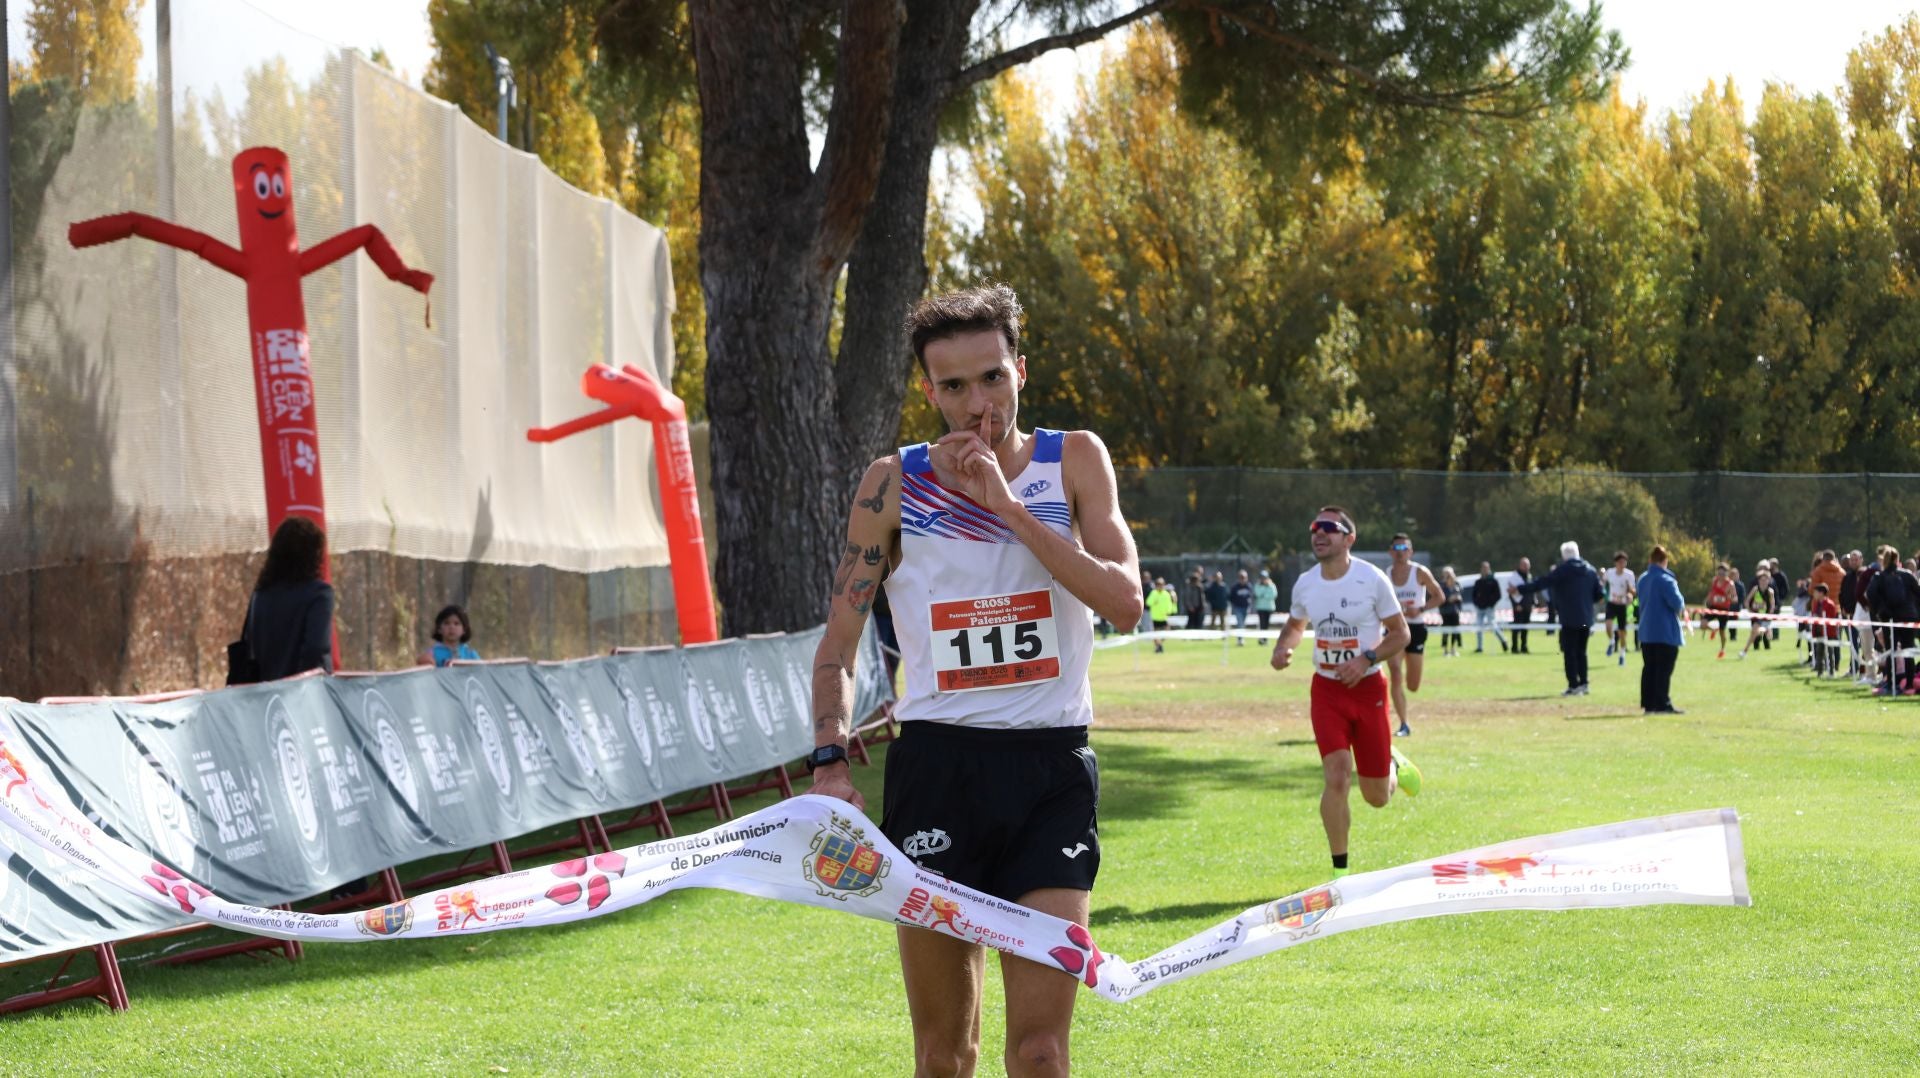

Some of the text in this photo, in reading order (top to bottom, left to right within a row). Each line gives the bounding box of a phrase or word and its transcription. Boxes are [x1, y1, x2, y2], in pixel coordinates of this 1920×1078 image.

[272, 379, 289, 418] CIA
[973, 596, 1011, 609] CROSS
[976, 608, 1005, 616] Municipal
[970, 613, 1018, 626] Palencia
[950, 621, 1043, 667] 115
[227, 790, 252, 815] LEN
[236, 814, 258, 839] CIA
[50, 835, 62, 846] de
[638, 835, 711, 857] Patronato
[670, 857, 689, 871] de
[914, 872, 1031, 919] Patronato Municipal de Deportes
[1590, 883, 1607, 892] de
[1612, 882, 1680, 893] Deportes
[434, 894, 453, 931] PMD
[898, 887, 930, 922] PMD
[217, 909, 282, 929] Ayuntamiento
[284, 918, 295, 929] de
[1138, 970, 1157, 984] de
